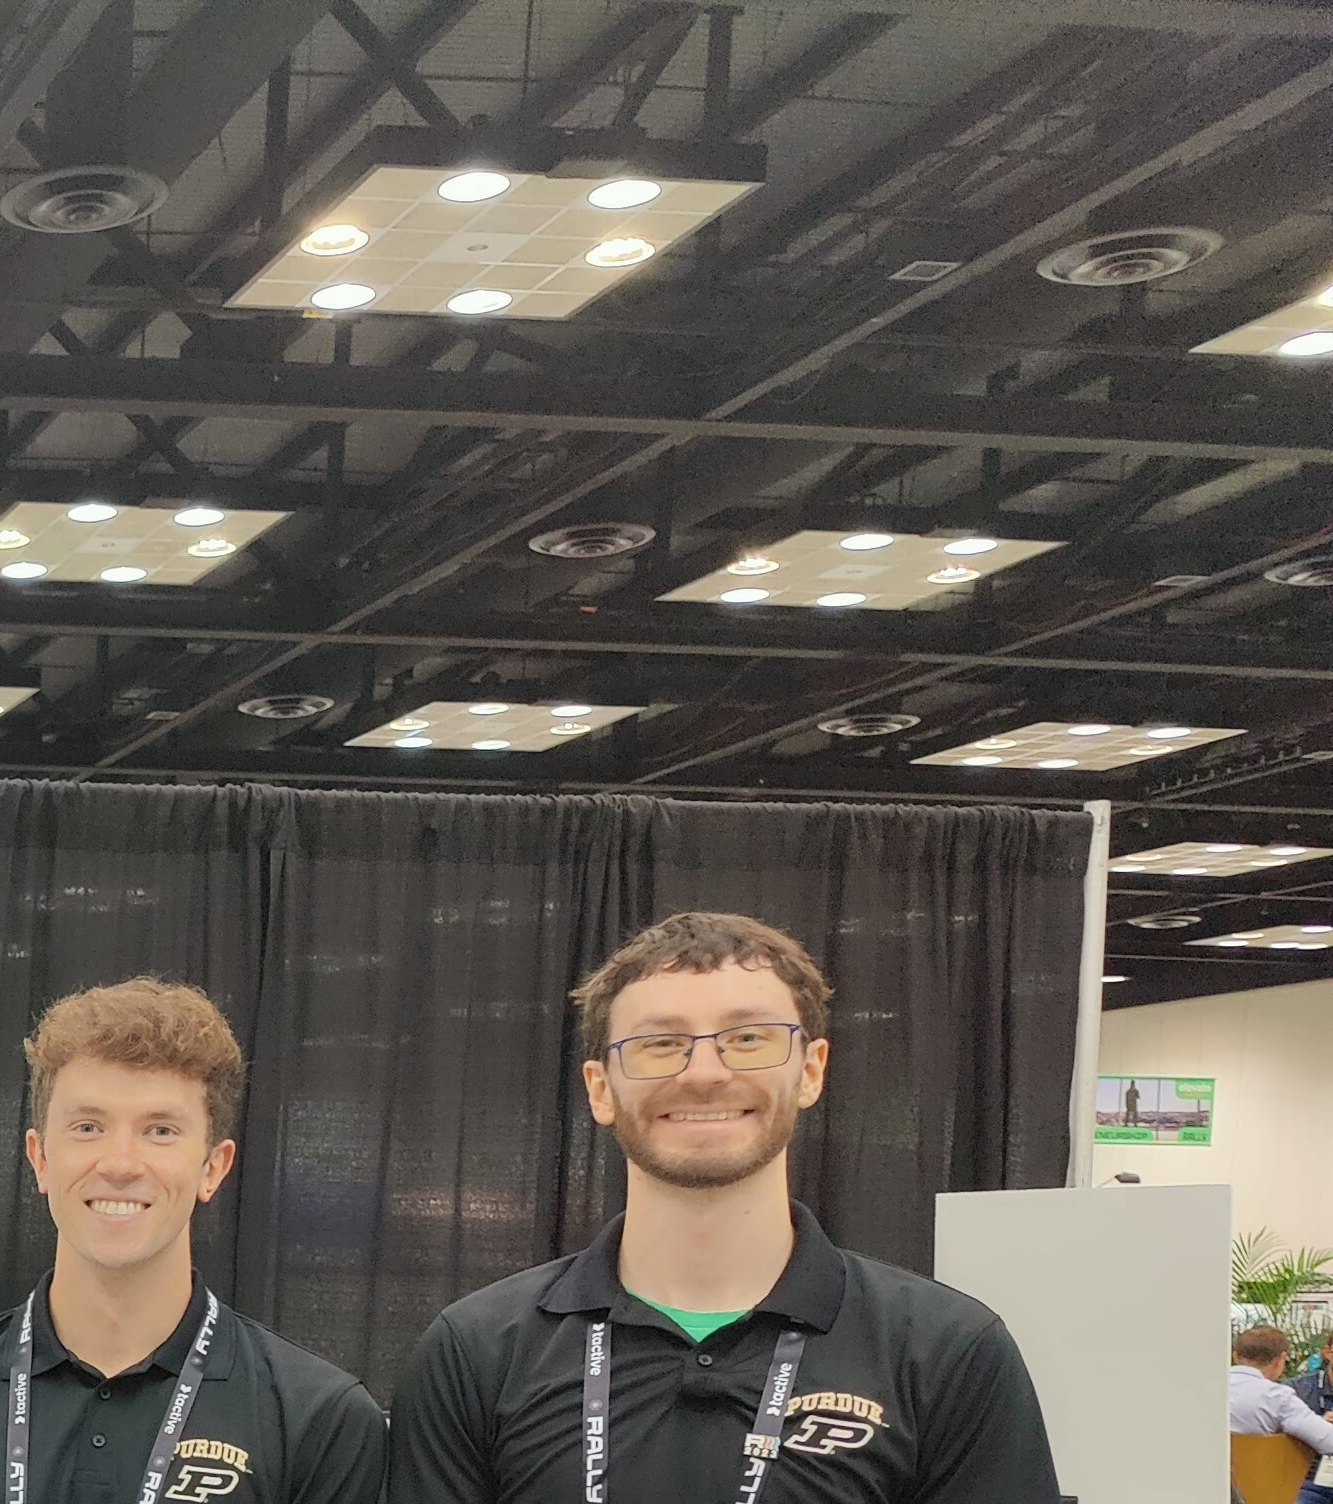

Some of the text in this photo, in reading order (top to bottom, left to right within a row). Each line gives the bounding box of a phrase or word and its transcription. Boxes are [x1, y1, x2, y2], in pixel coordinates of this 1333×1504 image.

[591, 1331, 603, 1377] tactive
[15, 1373, 27, 1414] tactive
[773, 1363, 792, 1402] tactive
[164, 1391, 192, 1435] tactive
[784, 1392, 883, 1425] PURDUE
[586, 1416, 603, 1504] RALLY
